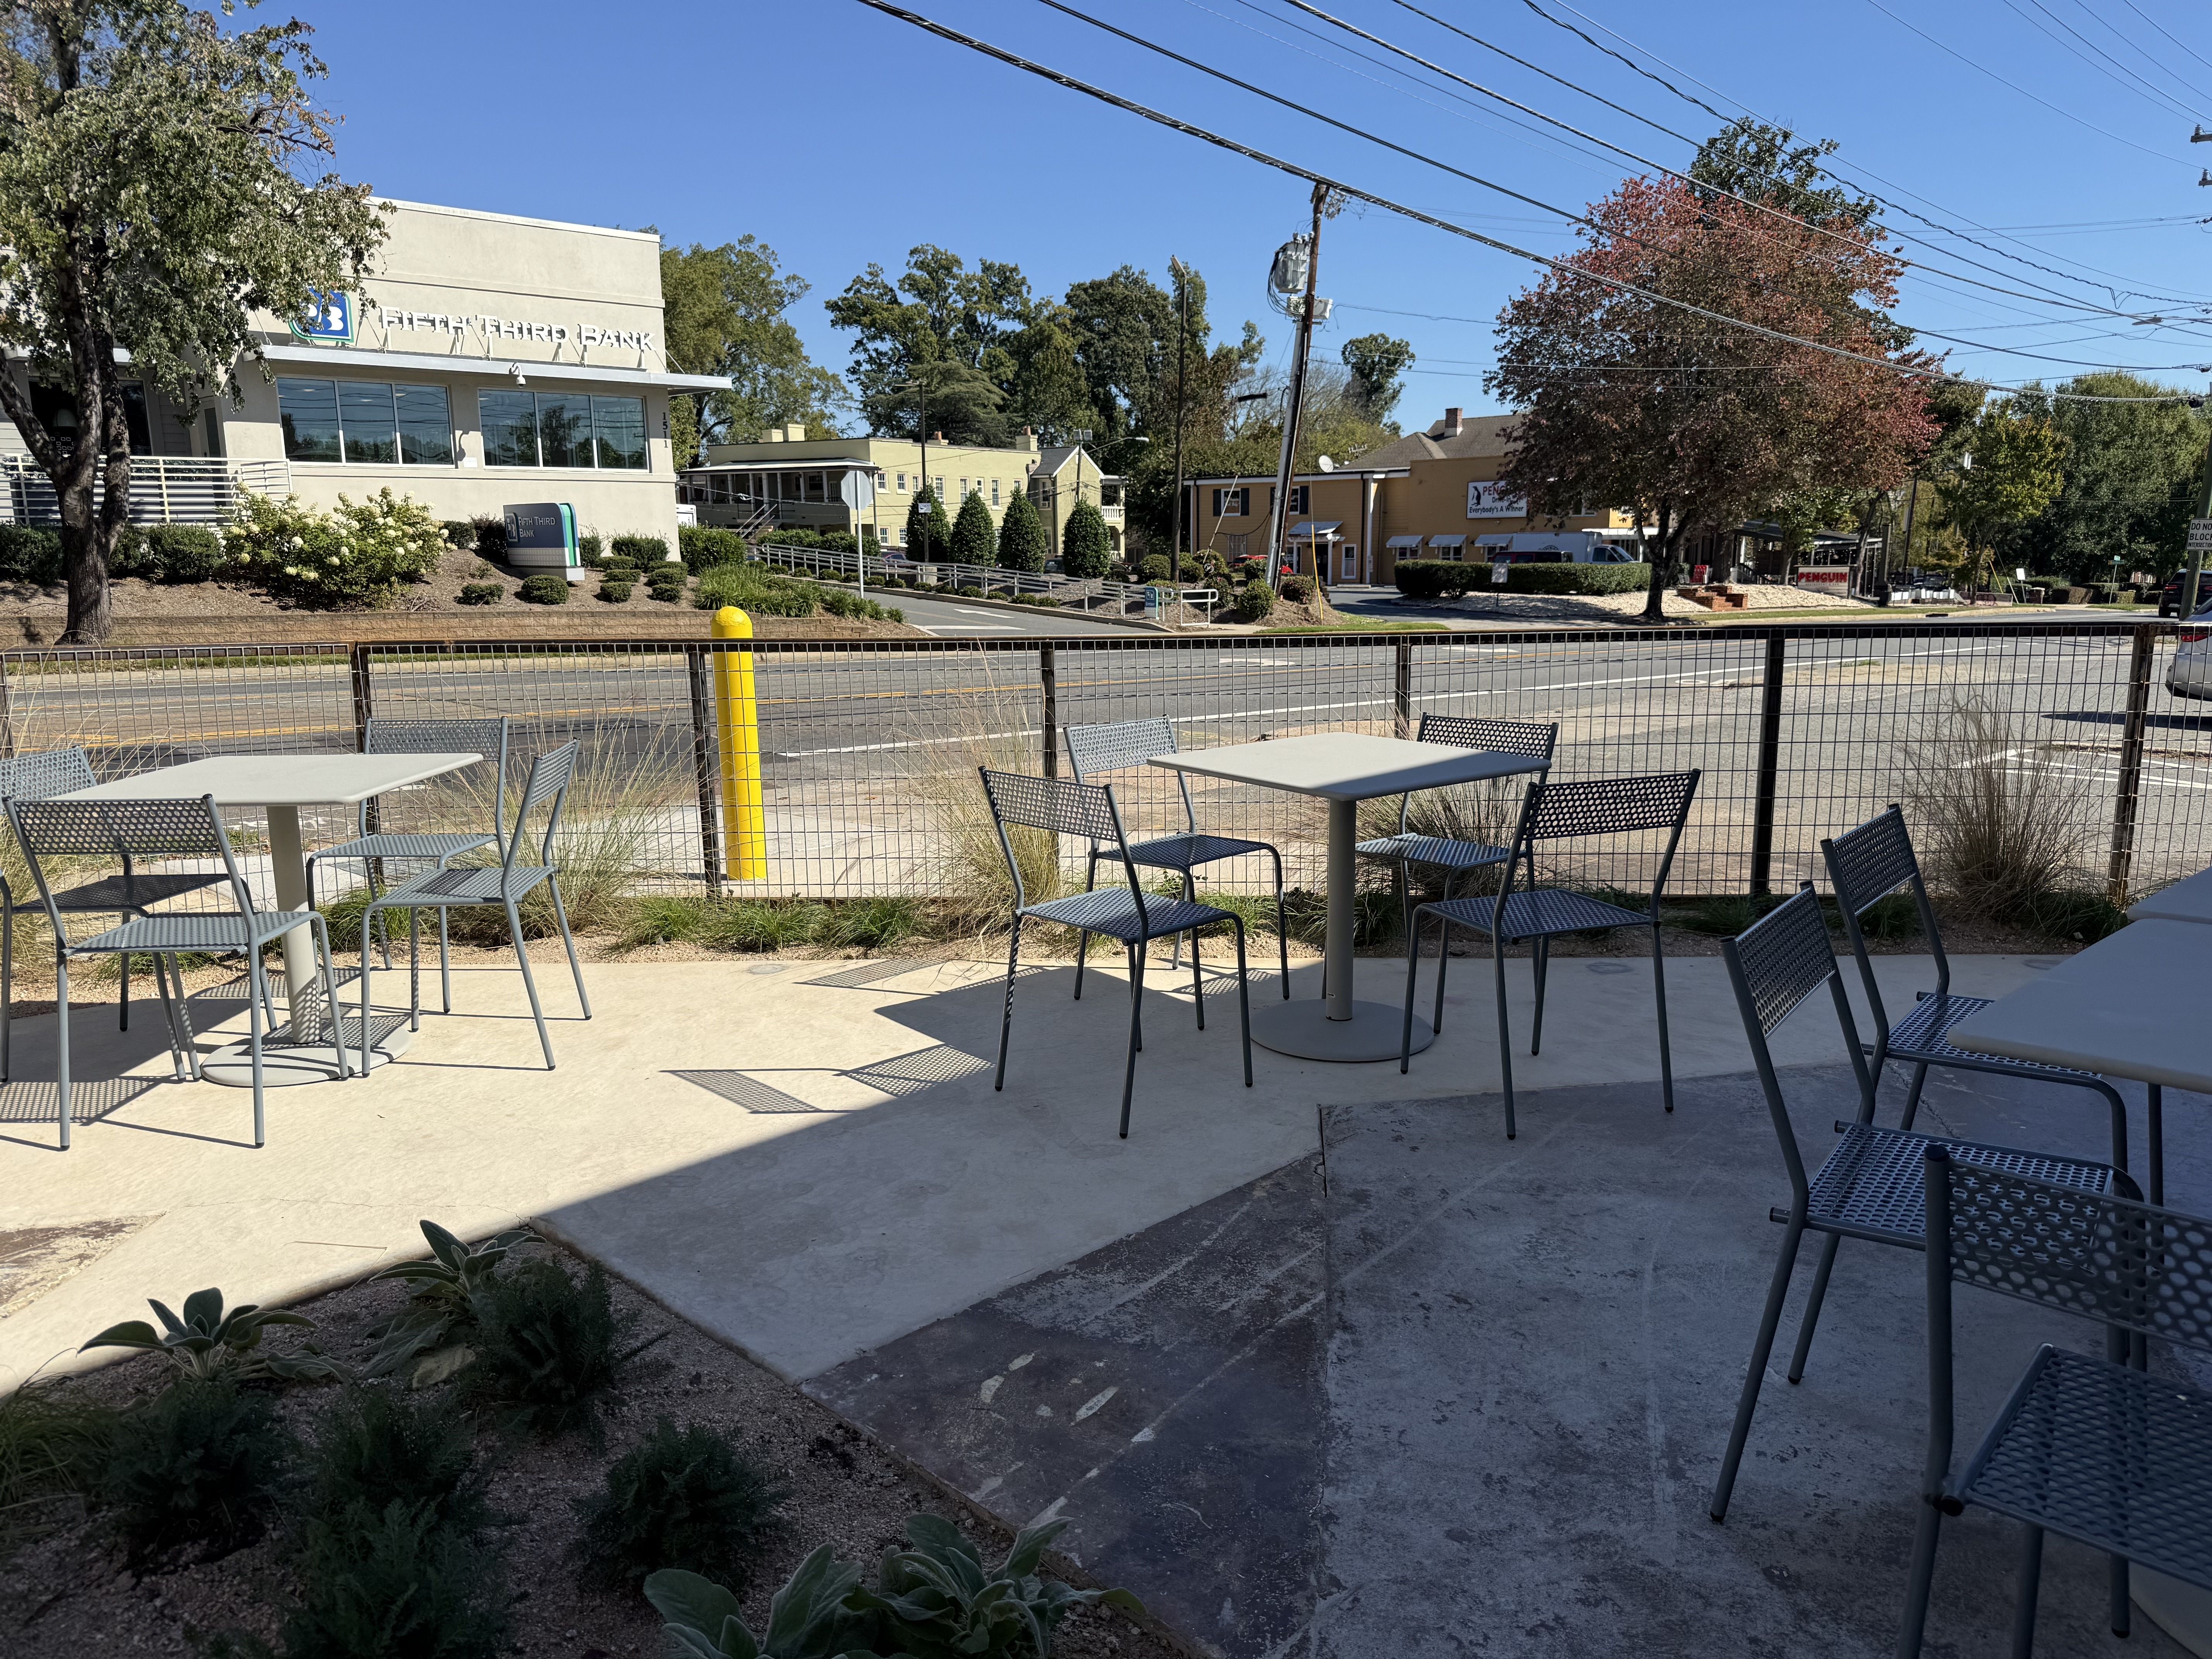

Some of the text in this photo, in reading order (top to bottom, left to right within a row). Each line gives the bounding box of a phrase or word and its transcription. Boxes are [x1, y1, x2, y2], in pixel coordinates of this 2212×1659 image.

[379, 306, 656, 351] FIFTH THIRD BANK
[1469, 506, 1498, 515] Everybody's
[518, 516, 556, 526] FIFTH THIRD
[519, 529, 534, 538] BANK
[1798, 572, 1847, 583] PENGUIN
